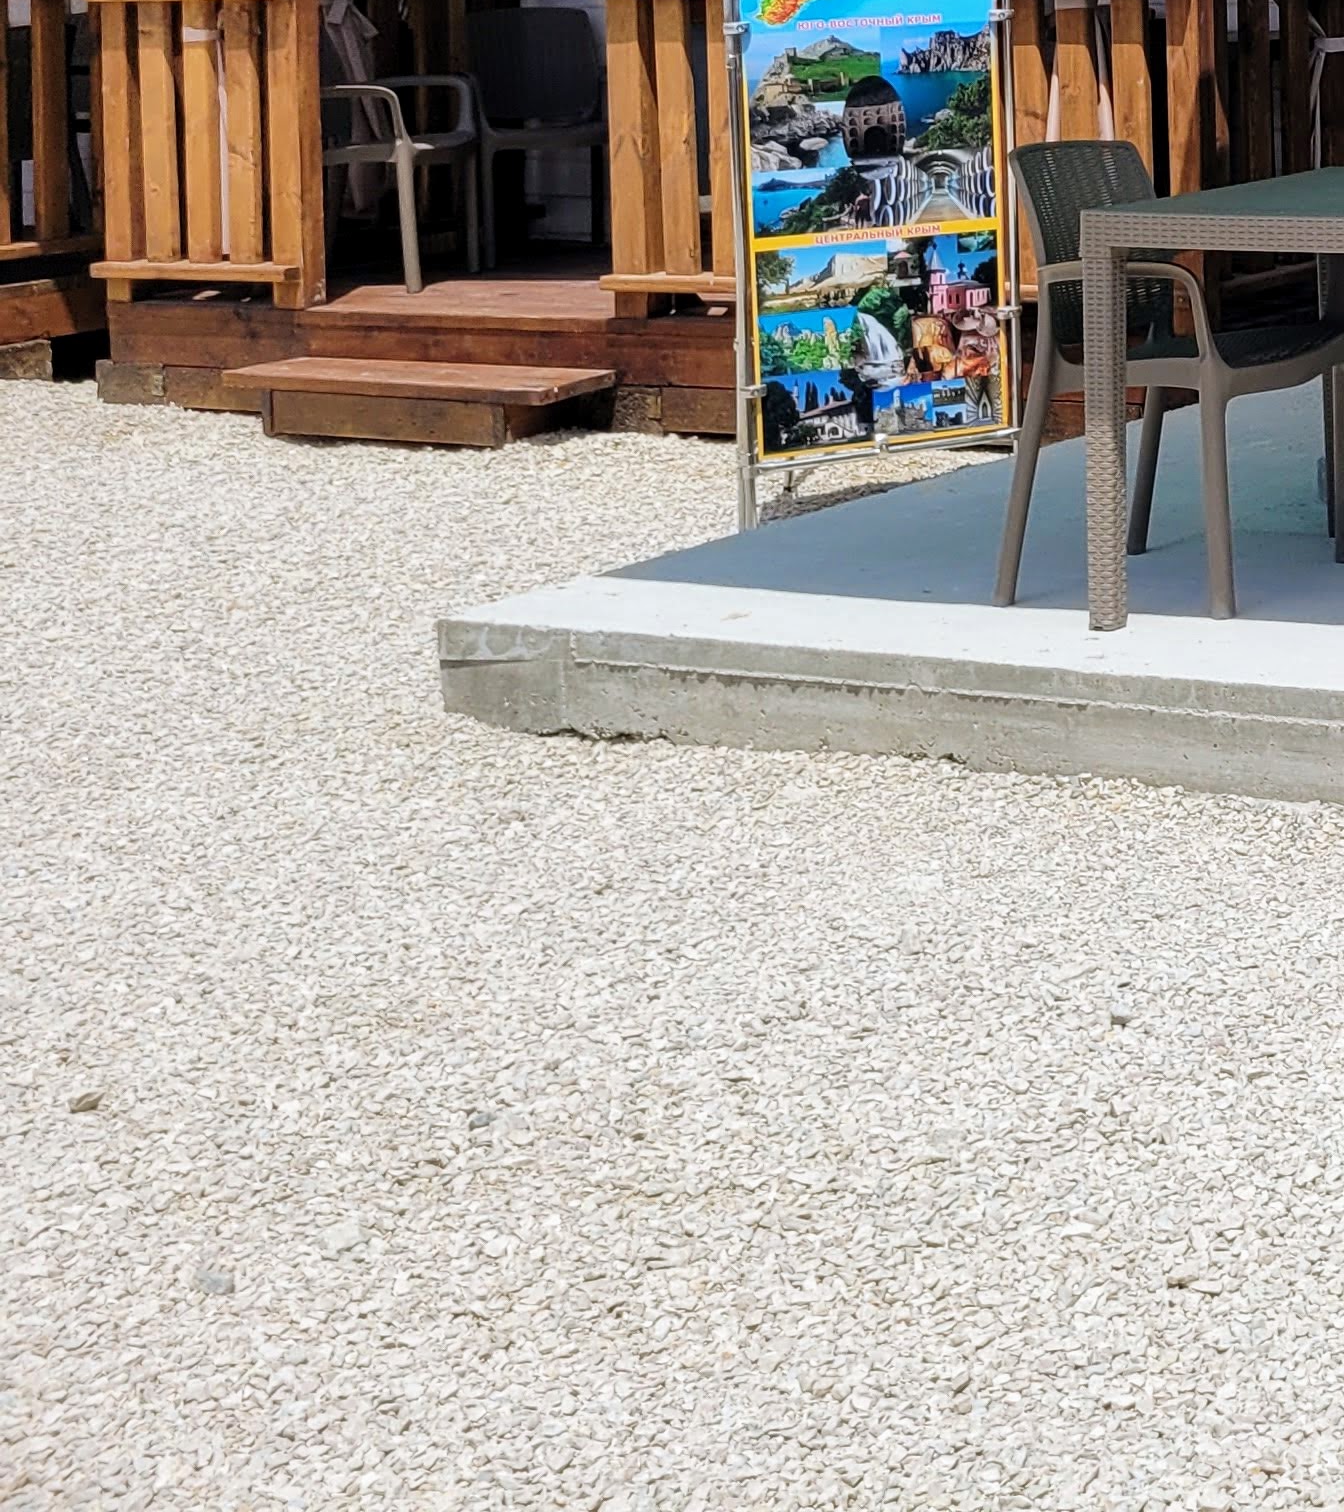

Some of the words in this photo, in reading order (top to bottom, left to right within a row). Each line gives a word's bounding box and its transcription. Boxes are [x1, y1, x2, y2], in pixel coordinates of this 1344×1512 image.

[797, 15, 903, 31] ЮГО-ВОСТОЧНЫЙ
[907, 13, 942, 25] КРЫМ
[815, 228, 903, 245] ЦЕНТРАЛЬНЫЙ
[907, 224, 941, 236] КРЫМ
